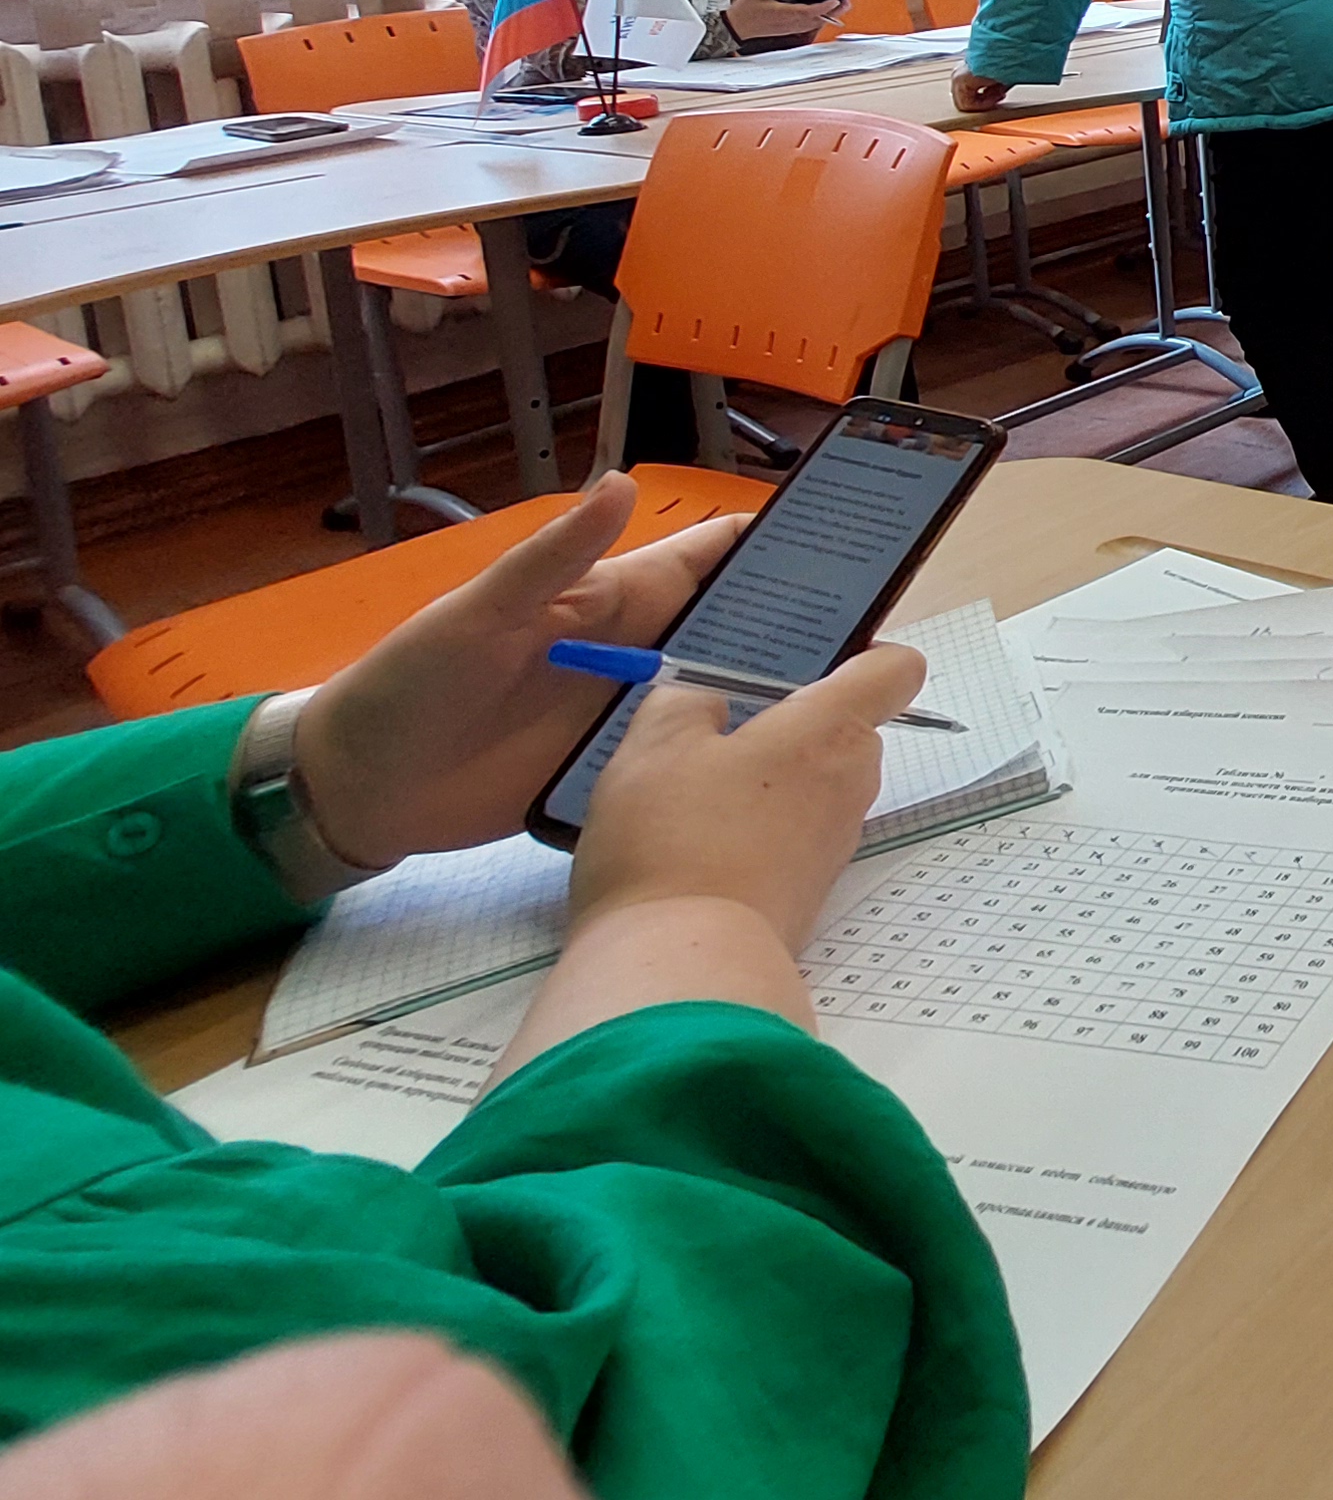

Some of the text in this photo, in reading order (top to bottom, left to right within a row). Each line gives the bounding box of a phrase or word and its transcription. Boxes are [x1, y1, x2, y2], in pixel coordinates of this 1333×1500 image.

[1179, 862, 1196, 871] 16
[1226, 867, 1245, 877] 17
[1274, 872, 1292, 882] 18
[1160, 879, 1178, 889] 26
[1207, 885, 1229, 894] 27
[1256, 889, 1276, 900] 28
[1305, 894, 1324, 904] 29
[1142, 896, 1161, 907] 36
[1190, 902, 1211, 912] 37
[1289, 913, 1308, 923] 39
[1173, 921, 1194, 930] 47
[1224, 927, 1243, 937] 48
[1273, 933, 1292, 942] 49
[1104, 934, 1326, 969] 56 57 58 59 60
[1135, 961, 1156, 970] 67
[1187, 967, 1207, 977] 68
[1238, 973, 1258, 984] 69
[1292, 979, 1309, 990] 70
[1169, 987, 1188, 998] 78
[1221, 994, 1240, 1005] 79
[1272, 1001, 1292, 1012] 80
[1042, 996, 1275, 1034] 86 87 88 89 90
[1019, 1019, 1260, 1059] 96 97 98 99 100
[1039, 1168, 1082, 1182] ведет
